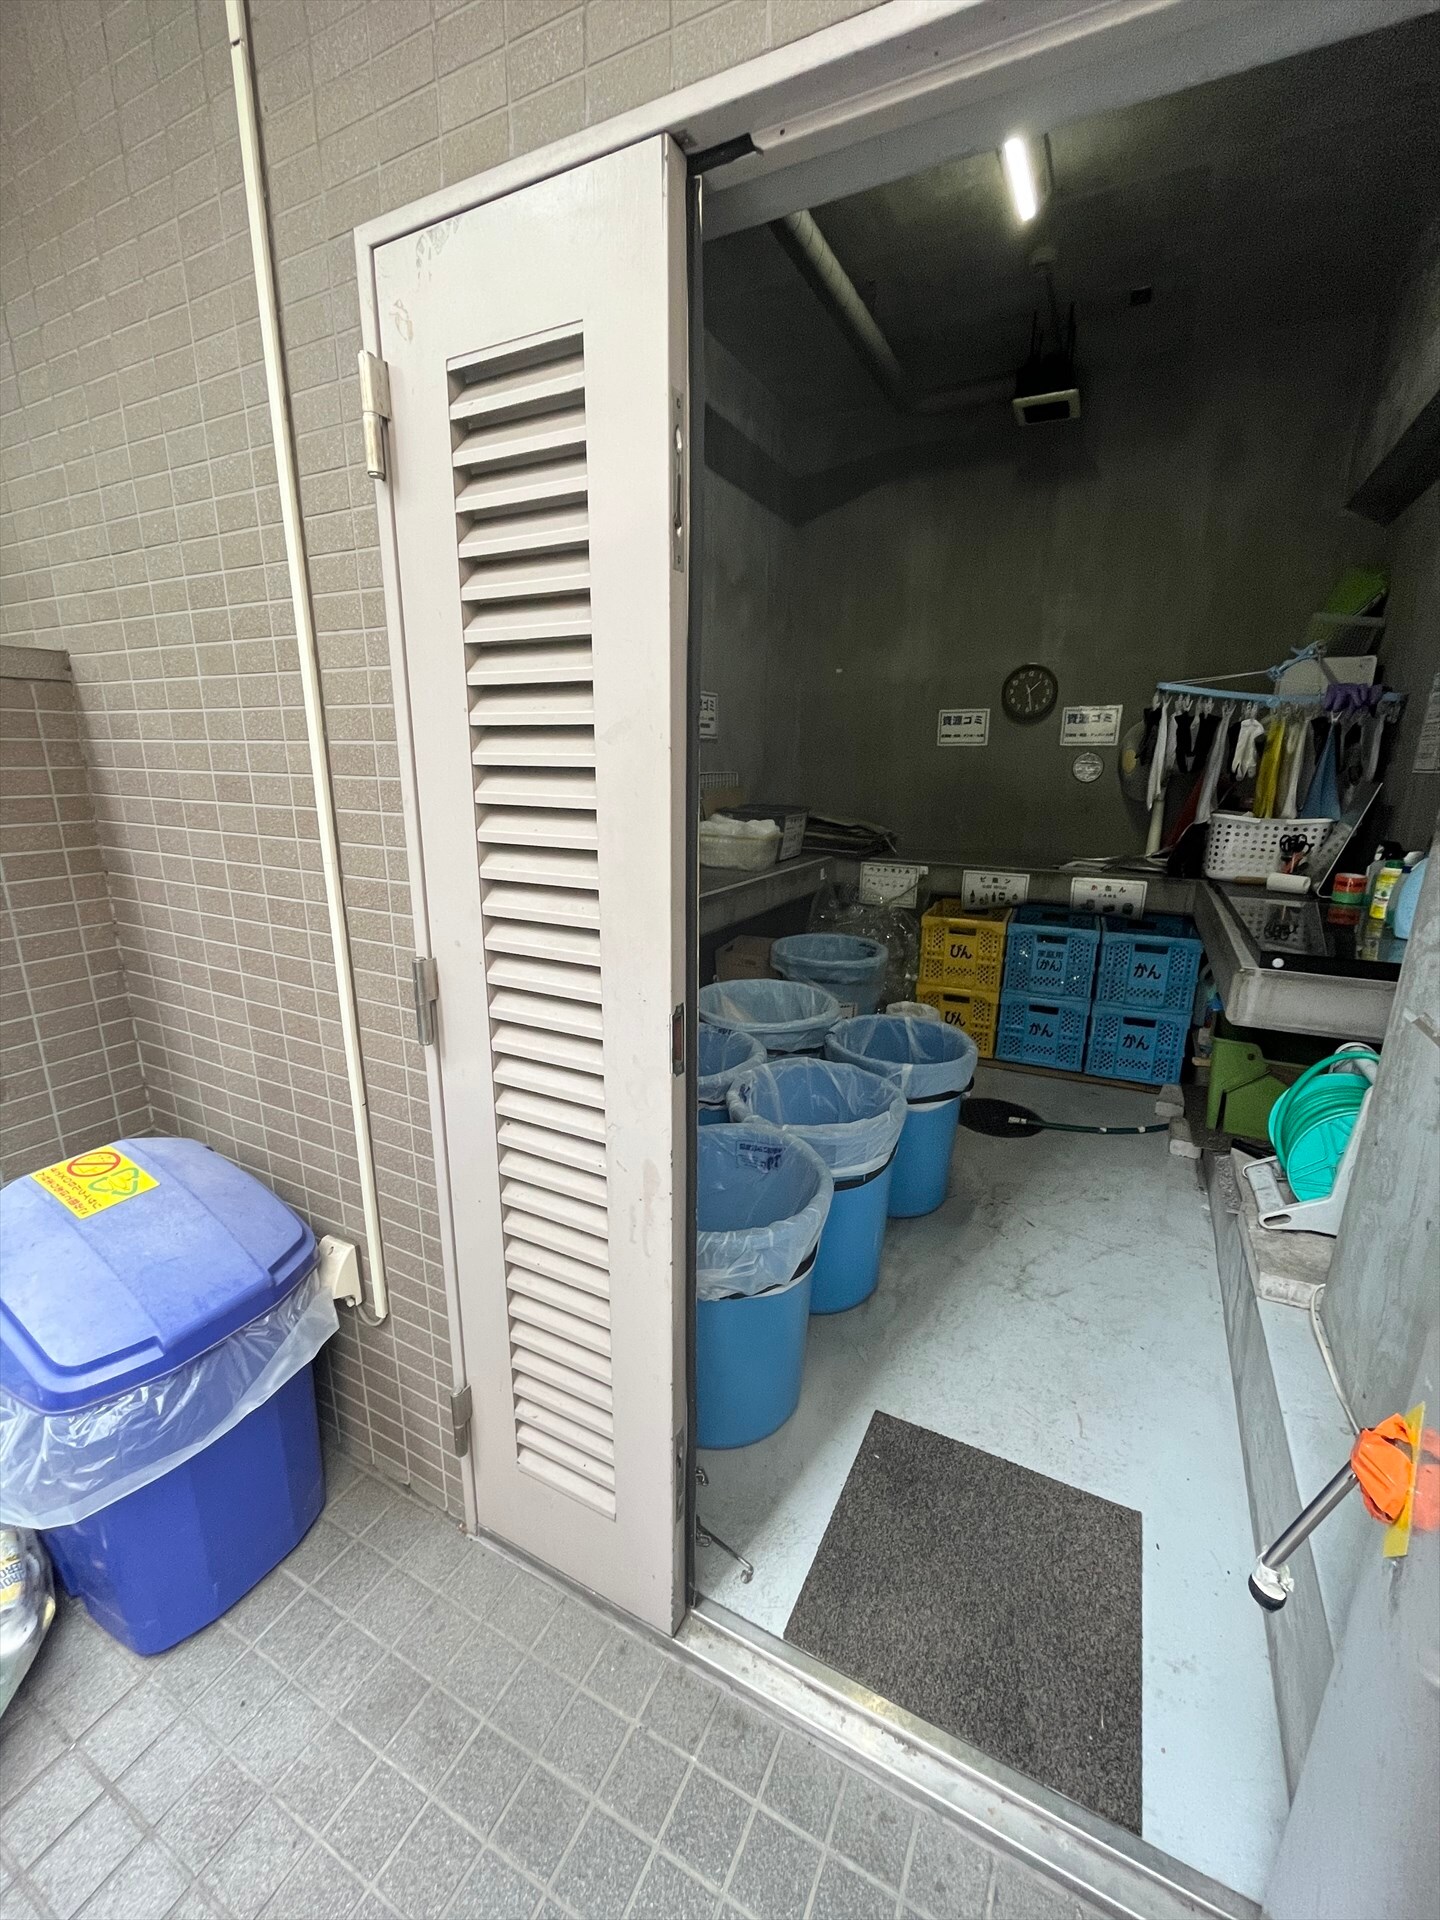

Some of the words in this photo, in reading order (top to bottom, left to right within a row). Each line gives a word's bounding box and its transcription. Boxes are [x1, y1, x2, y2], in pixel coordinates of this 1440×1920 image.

[943, 715, 983, 726] 資源ゴミ
[1067, 713, 1112, 725] 資源ゴミ
[950, 944, 972, 959] びん
[1133, 963, 1161, 980] かん
[944, 1011, 966, 1027] びん
[1028, 1022, 1053, 1038] かん
[1122, 1033, 1150, 1051] かん
